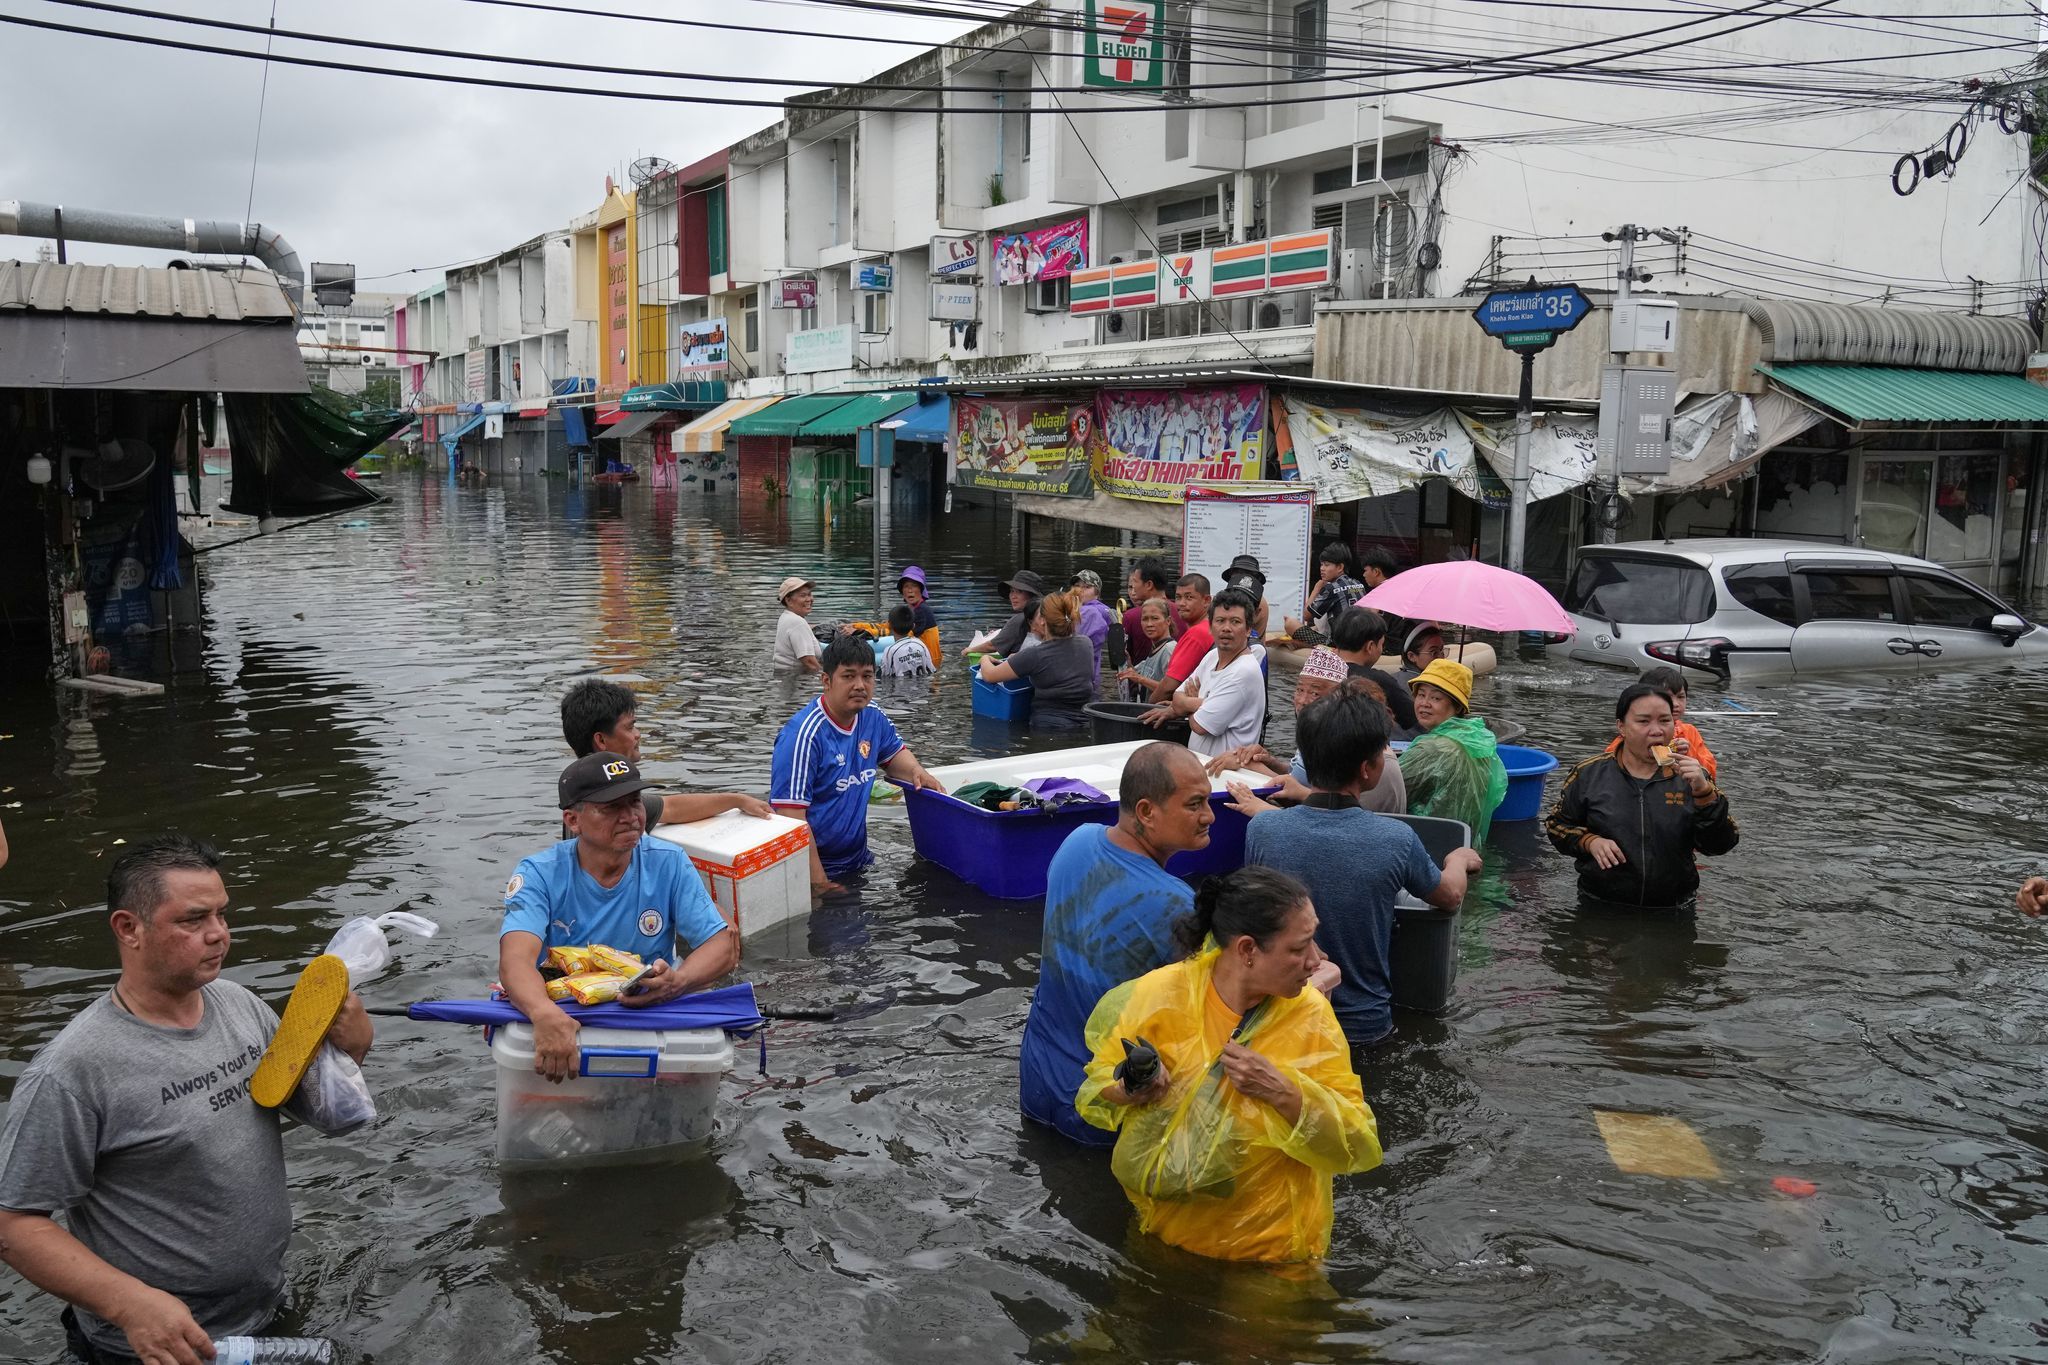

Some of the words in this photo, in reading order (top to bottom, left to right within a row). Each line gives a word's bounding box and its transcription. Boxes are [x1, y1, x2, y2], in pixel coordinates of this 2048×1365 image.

[938, 260, 963, 275] PERFECT
[1490, 292, 1544, 313] เคหะร่มเกล้า
[1545, 294, 1573, 318] 35
[1489, 315, 1507, 323] Kheha
[1520, 312, 1534, 320] Klao
[1059, 482, 1069, 493] 68
[161, 1070, 218, 1106] Always
[216, 1052, 248, 1078] Your
[208, 1074, 254, 1112] SERVIC
